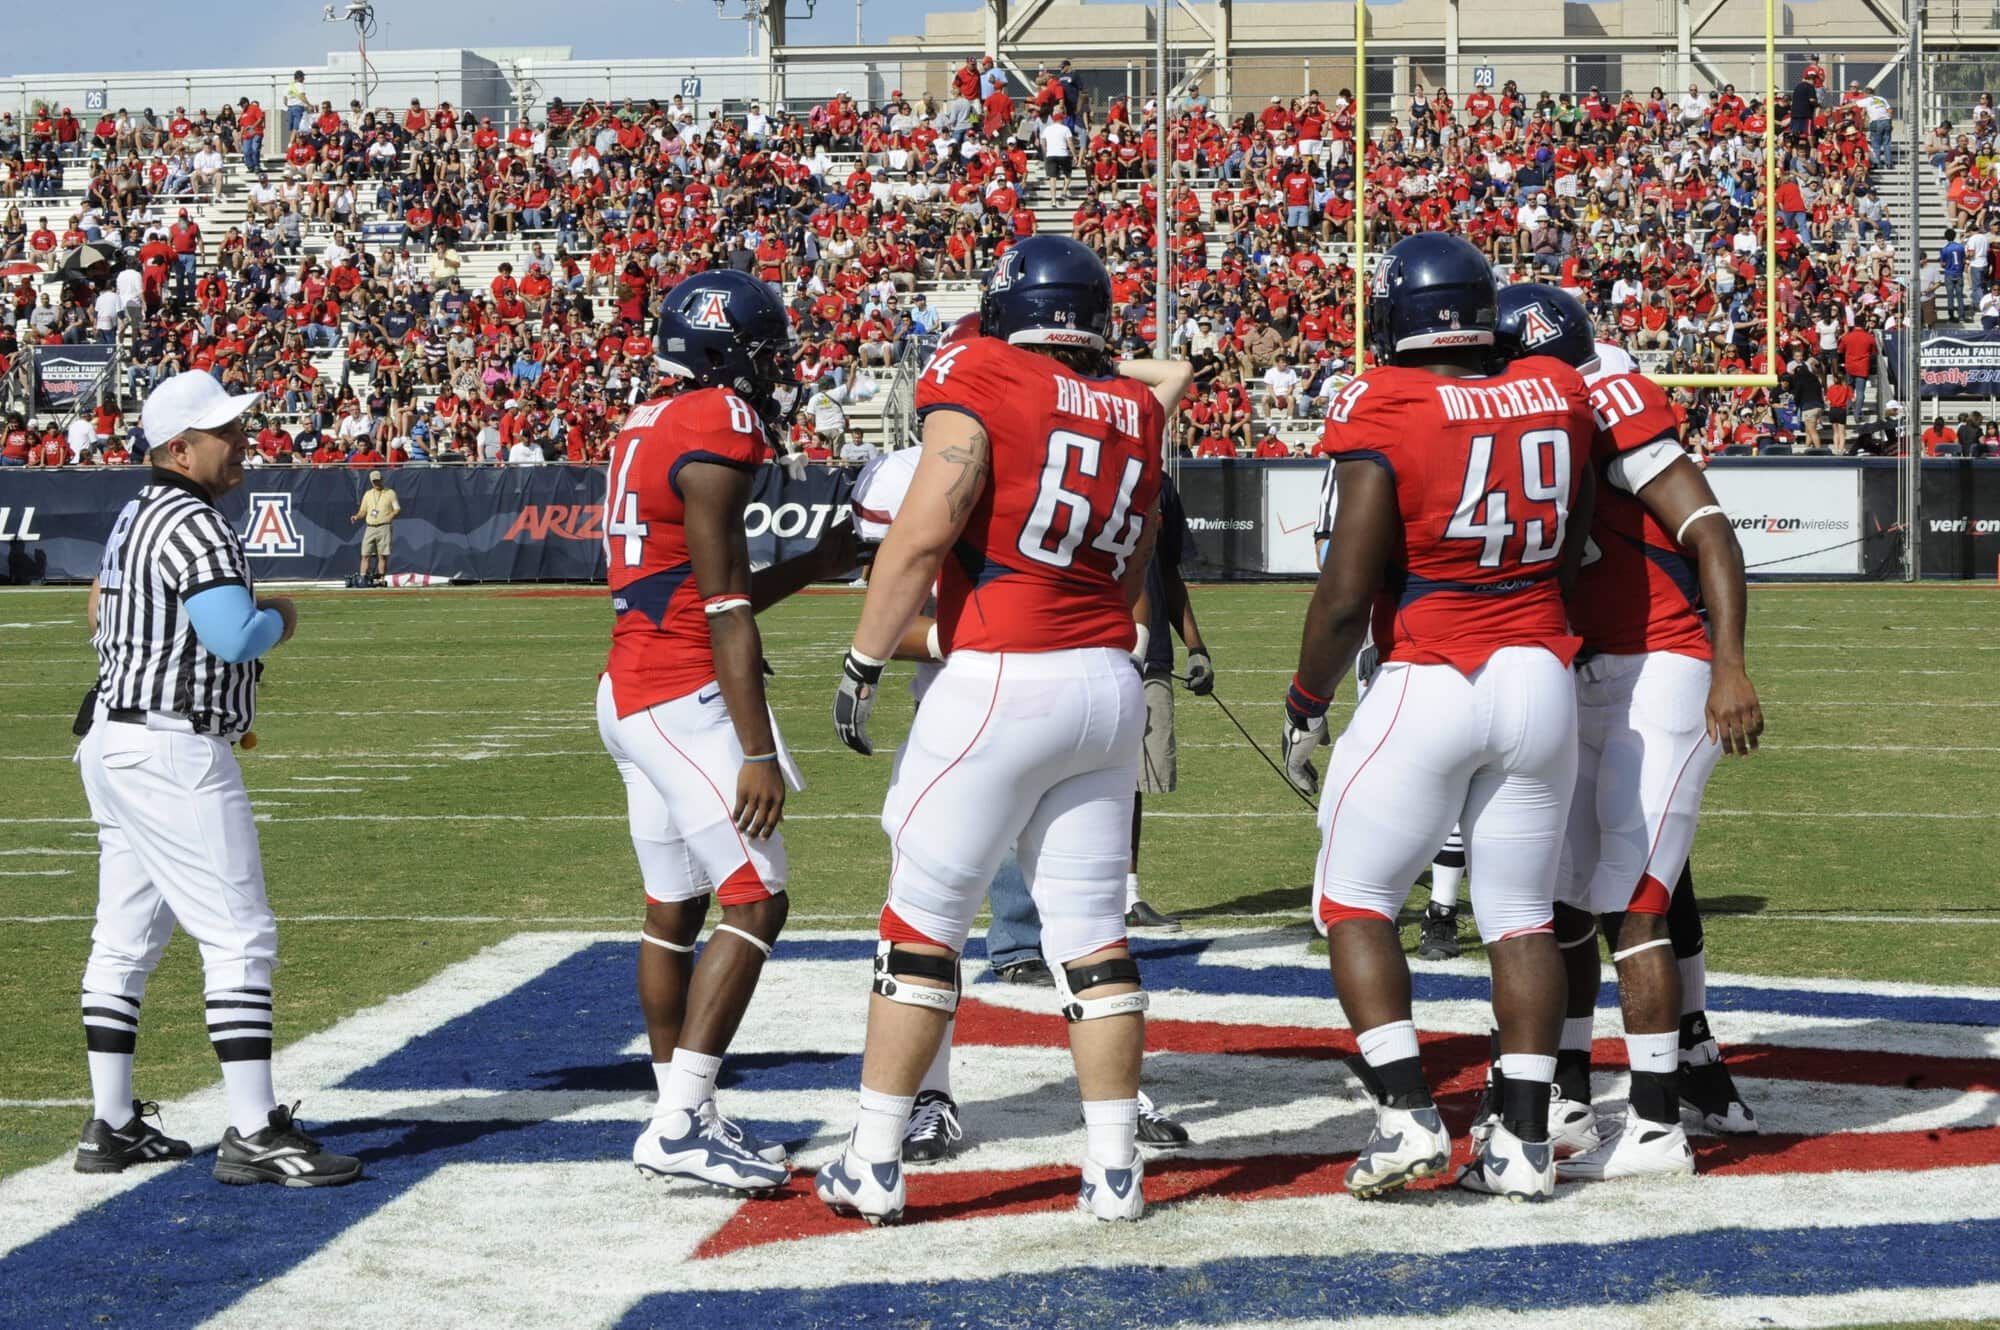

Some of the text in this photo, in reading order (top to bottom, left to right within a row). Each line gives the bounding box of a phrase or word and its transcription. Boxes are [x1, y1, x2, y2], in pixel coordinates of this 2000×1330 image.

[1476, 69, 1492, 86] 28
[684, 80, 698, 96] 27
[87, 92, 102, 108] 26
[1952, 251, 1959, 265] 1
[692, 290, 735, 332] A
[1054, 311, 1067, 322] 64
[1438, 309, 1450, 321] 49
[1513, 302, 1564, 350] A
[1044, 332, 1092, 346] ARIZONA
[1432, 334, 1479, 346] ARIZONA
[1436, 377, 1569, 421] MITCHELL
[1588, 378, 1645, 432] 20
[1018, 428, 1145, 581] 64
[1443, 427, 1573, 568] 49
[239, 492, 304, 557] A
